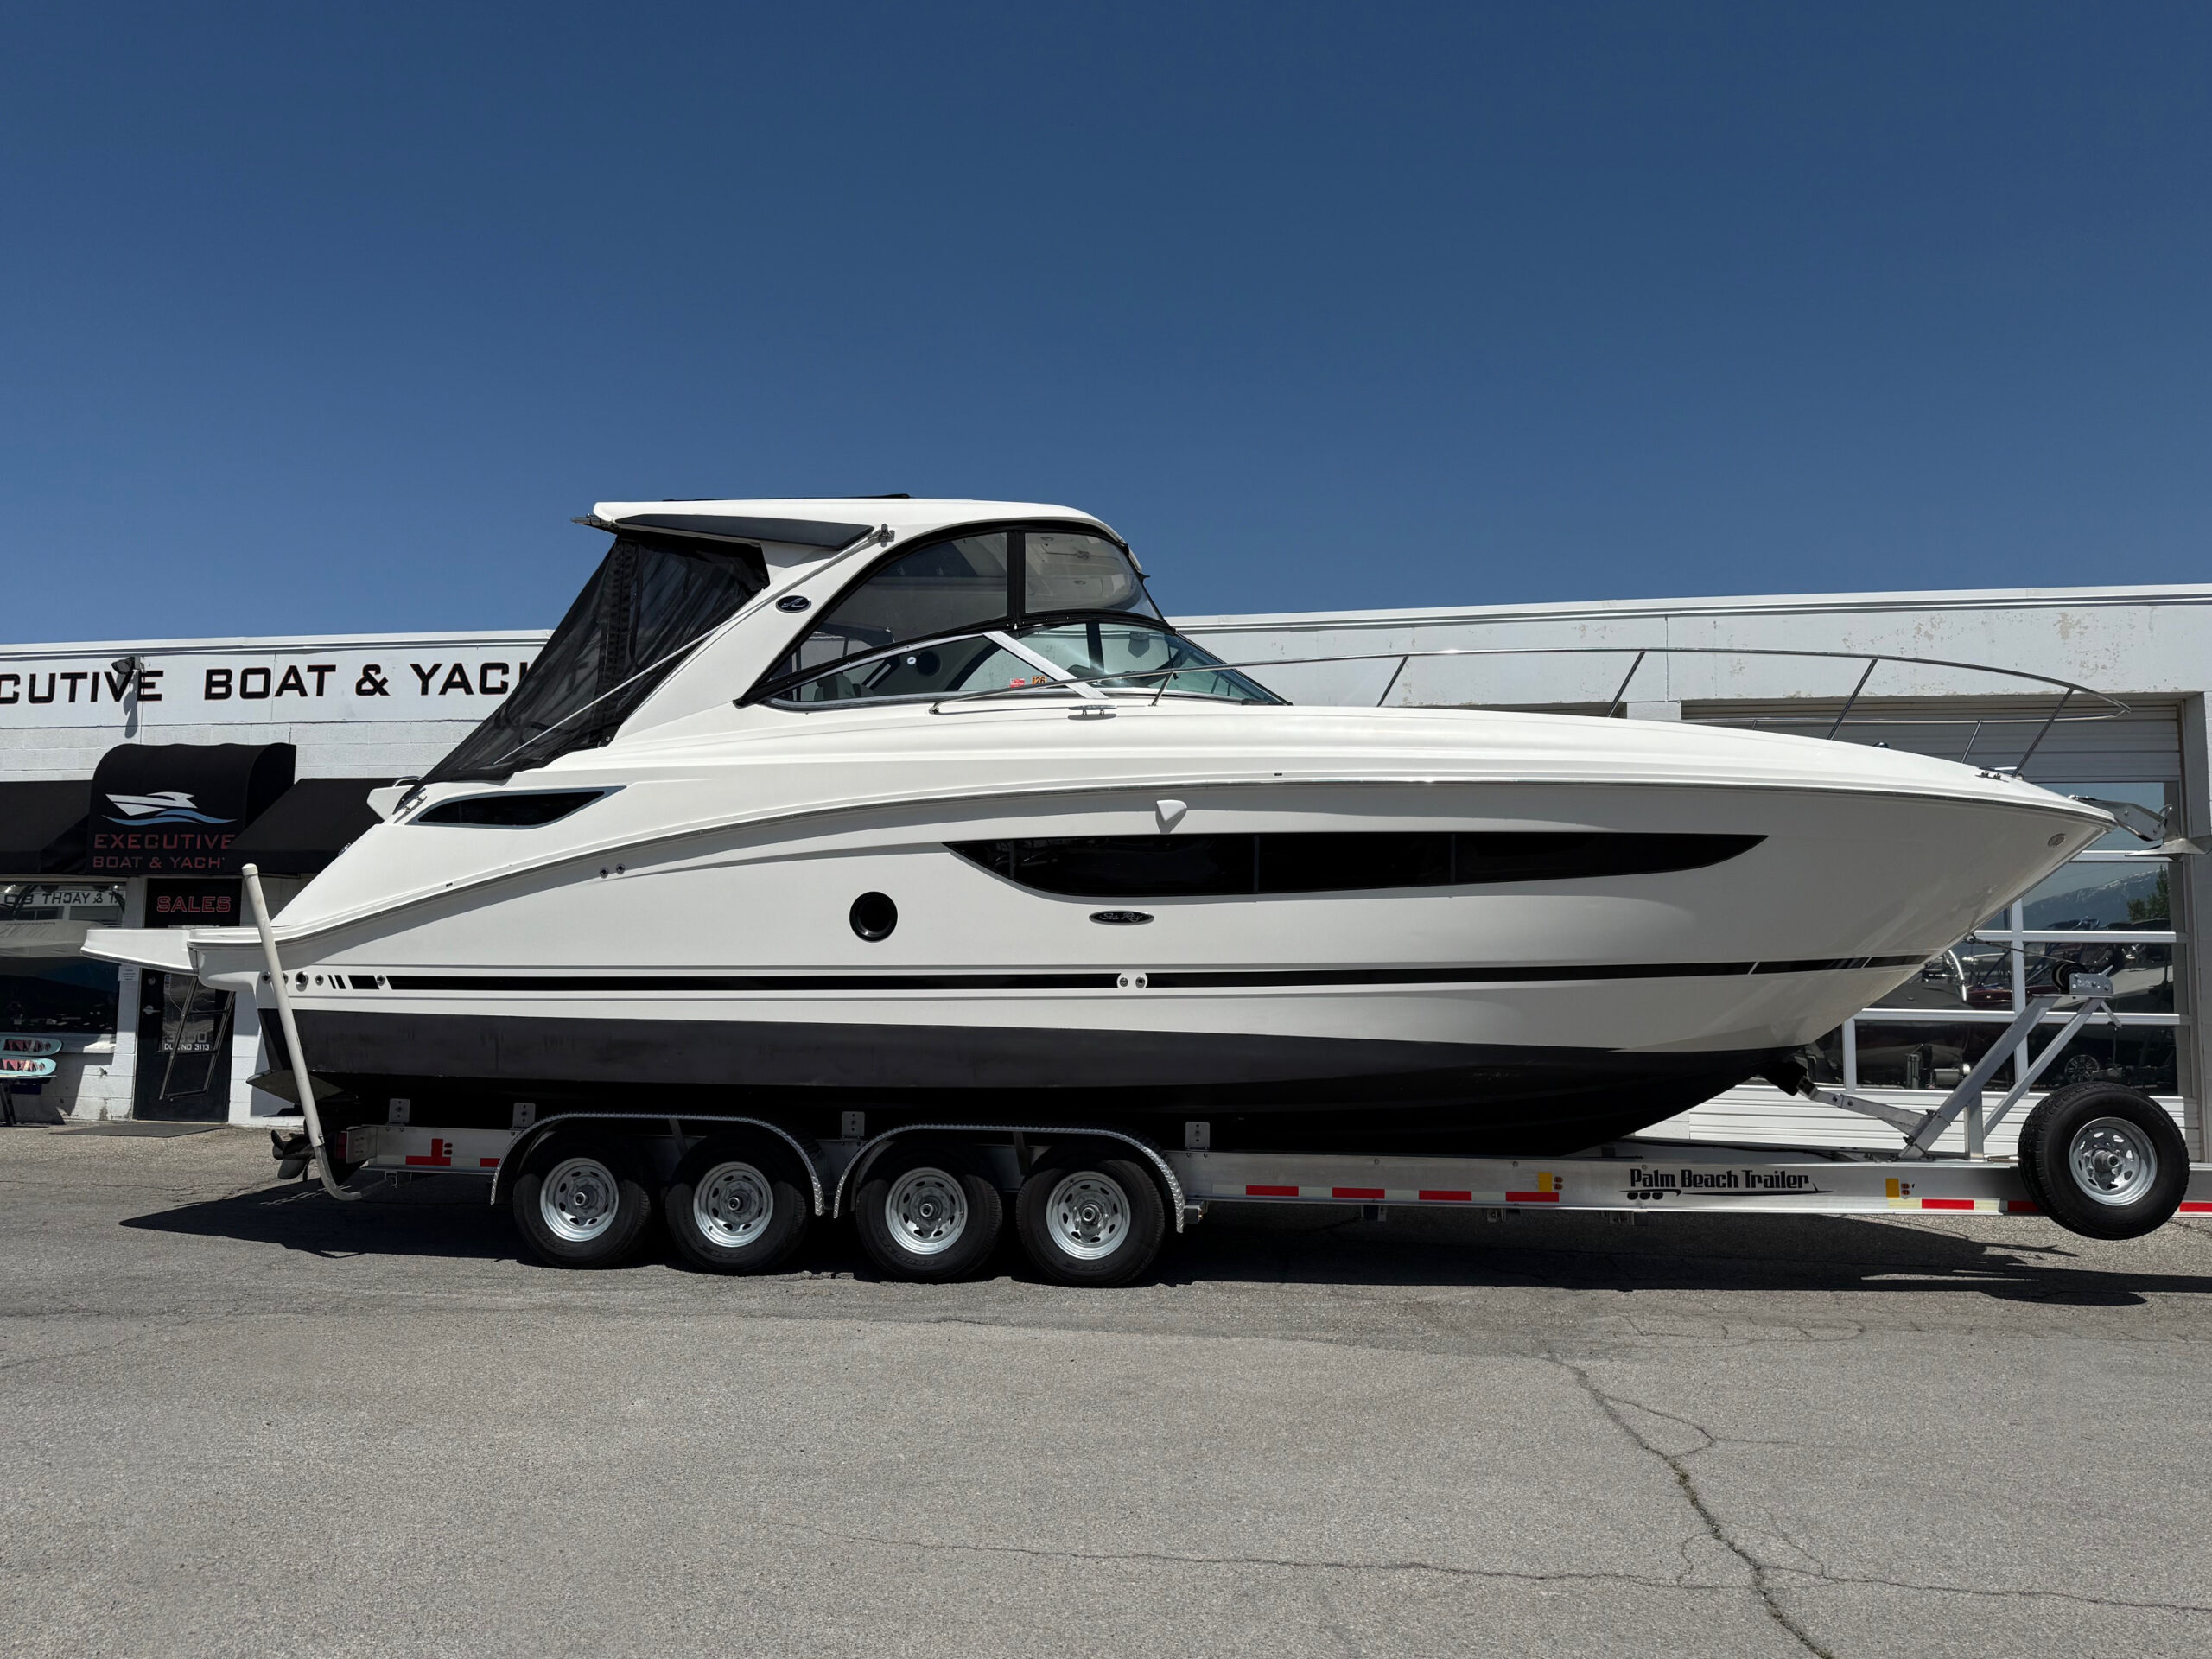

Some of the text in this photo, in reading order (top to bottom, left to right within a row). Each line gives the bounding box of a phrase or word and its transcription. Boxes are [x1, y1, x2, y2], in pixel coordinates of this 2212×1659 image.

[204, 664, 336, 700] BOAT
[355, 664, 391, 696] &
[93, 834, 235, 849] EXECUTIVE
[92, 856, 226, 869] BOAT & YACH
[156, 895, 232, 912] SALES
[1122, 912, 1143, 923] Ray
[1630, 1168, 1810, 1189] Palm Beach Trailer
